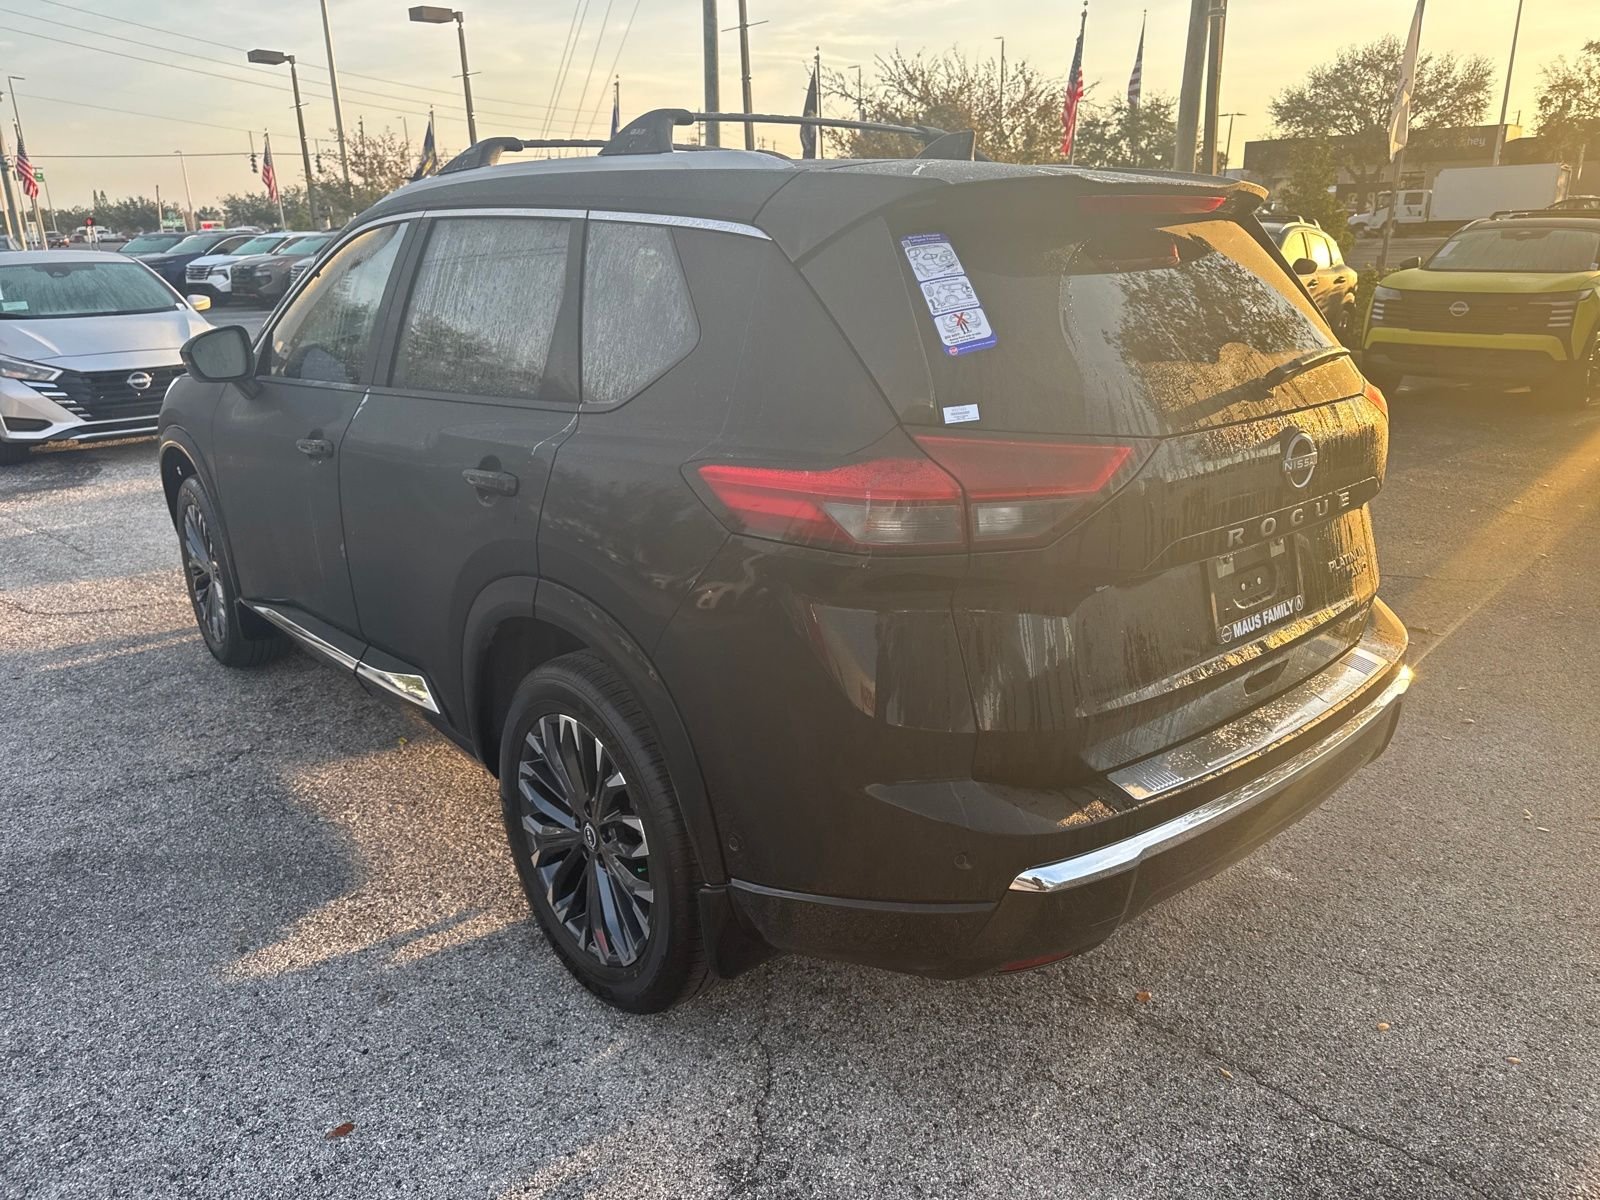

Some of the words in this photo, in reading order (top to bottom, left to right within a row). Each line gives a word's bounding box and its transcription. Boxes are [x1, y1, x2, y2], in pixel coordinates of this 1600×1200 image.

[1227, 491, 1350, 548] ROGUE
[1232, 613, 1262, 638] MAUS
[1262, 599, 1294, 625] FAMILY
